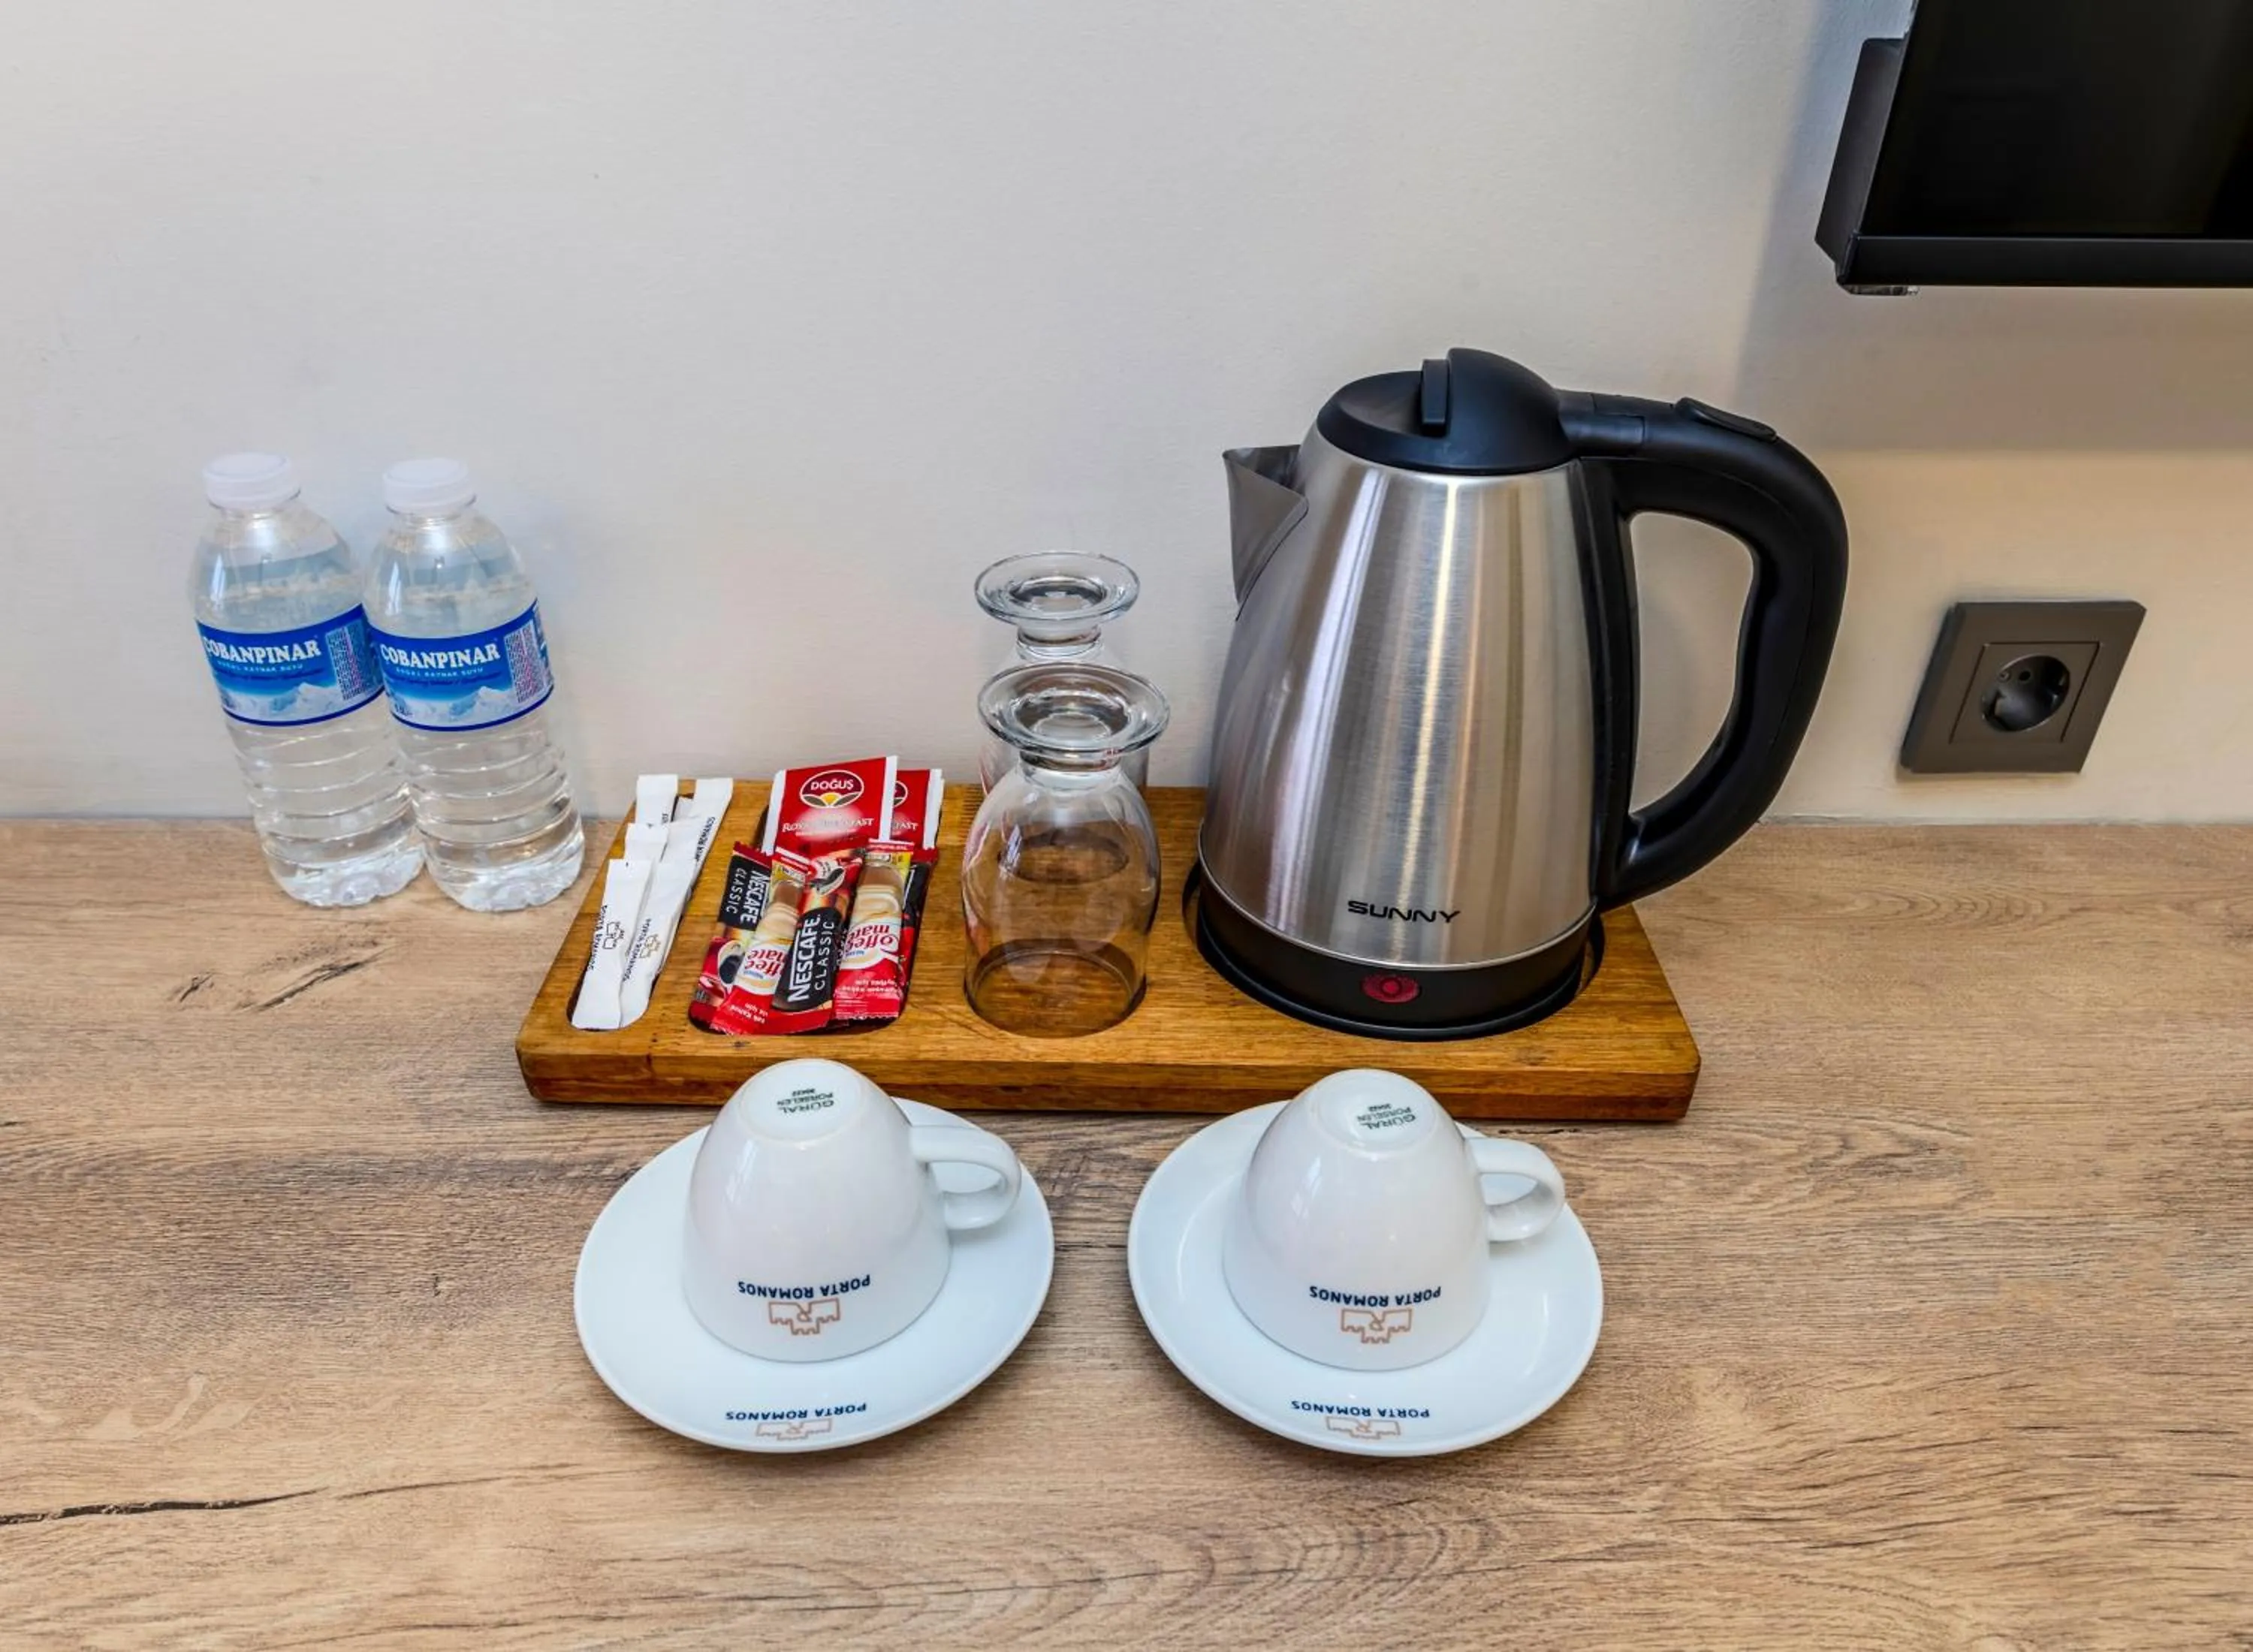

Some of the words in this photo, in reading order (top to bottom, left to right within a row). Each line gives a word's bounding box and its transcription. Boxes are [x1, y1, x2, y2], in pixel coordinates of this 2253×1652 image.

[810, 778, 855, 791] DOĞUŞ
[725, 867, 747, 915] CLASSIC
[1347, 900, 1461, 924] SUNNY
[814, 921, 835, 990] CLASSIC
[737, 1280, 814, 1300] ROMANOS
[819, 1274, 870, 1297] PORTA
[1309, 1285, 1389, 1307] ROMANOS
[1395, 1286, 1441, 1306] PORTA
[725, 1409, 808, 1421] ROMANOS
[815, 1402, 867, 1418] PORTA
[1291, 1400, 1371, 1417] ROMANOS
[1377, 1406, 1431, 1418] PORTA
